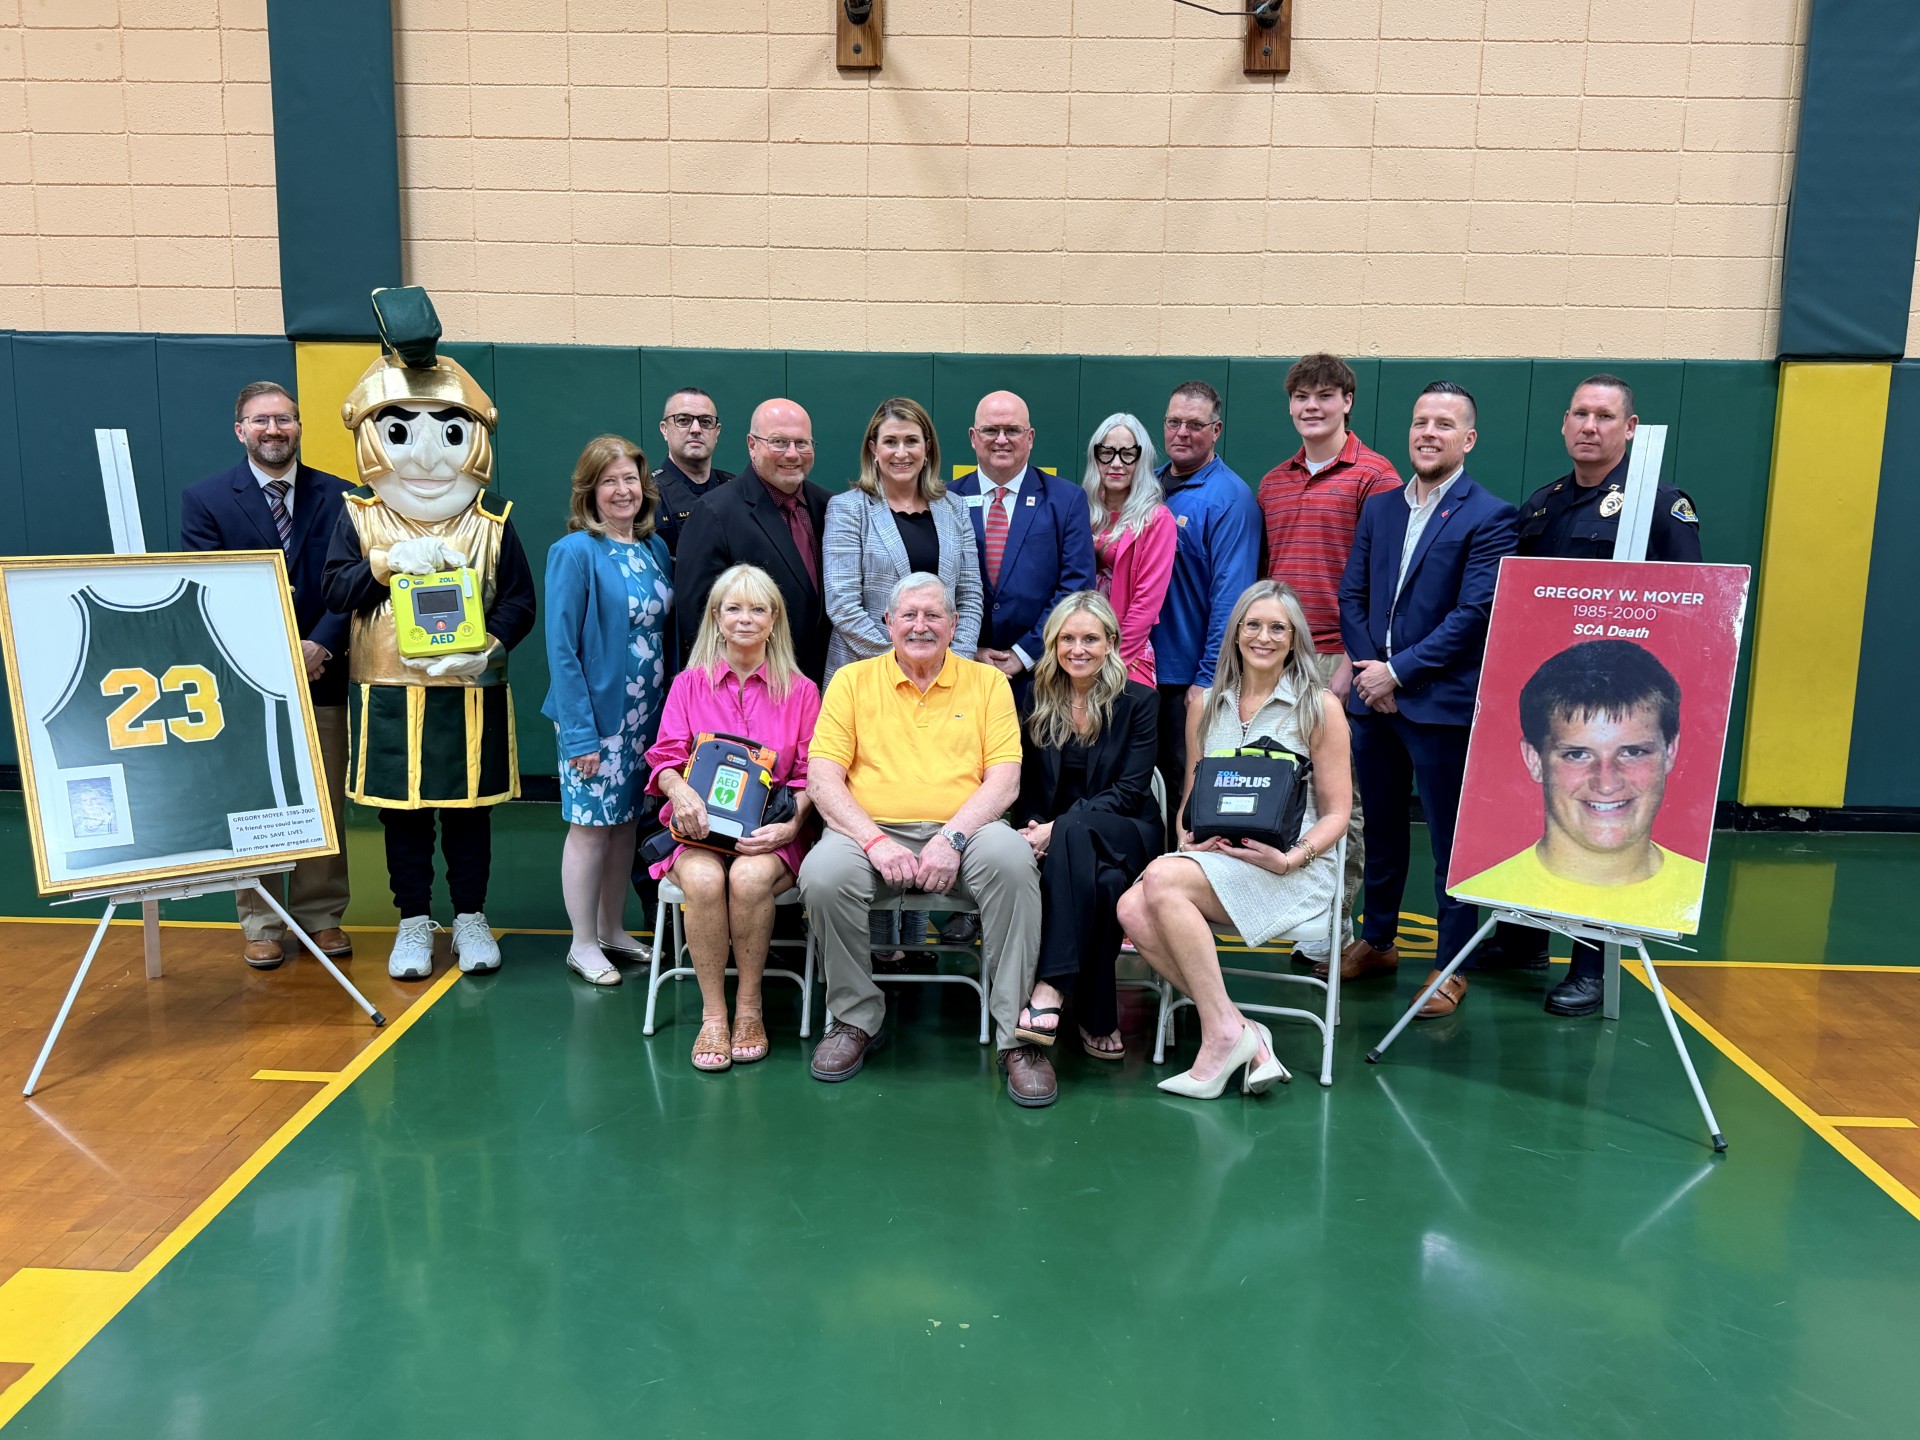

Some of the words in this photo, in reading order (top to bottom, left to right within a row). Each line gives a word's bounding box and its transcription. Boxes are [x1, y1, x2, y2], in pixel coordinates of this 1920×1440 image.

[1533, 586, 1615, 601] GREGORY
[1618, 589, 1638, 602] W.
[1643, 591, 1705, 605] MOYER
[1572, 604, 1657, 621] 1985-2000
[430, 633, 456, 645] AED
[1573, 623, 1604, 636] SCA
[1606, 625, 1650, 639] Death
[99, 663, 226, 751] 23
[717, 776, 739, 788] AED
[233, 814, 261, 822] GREGORY
